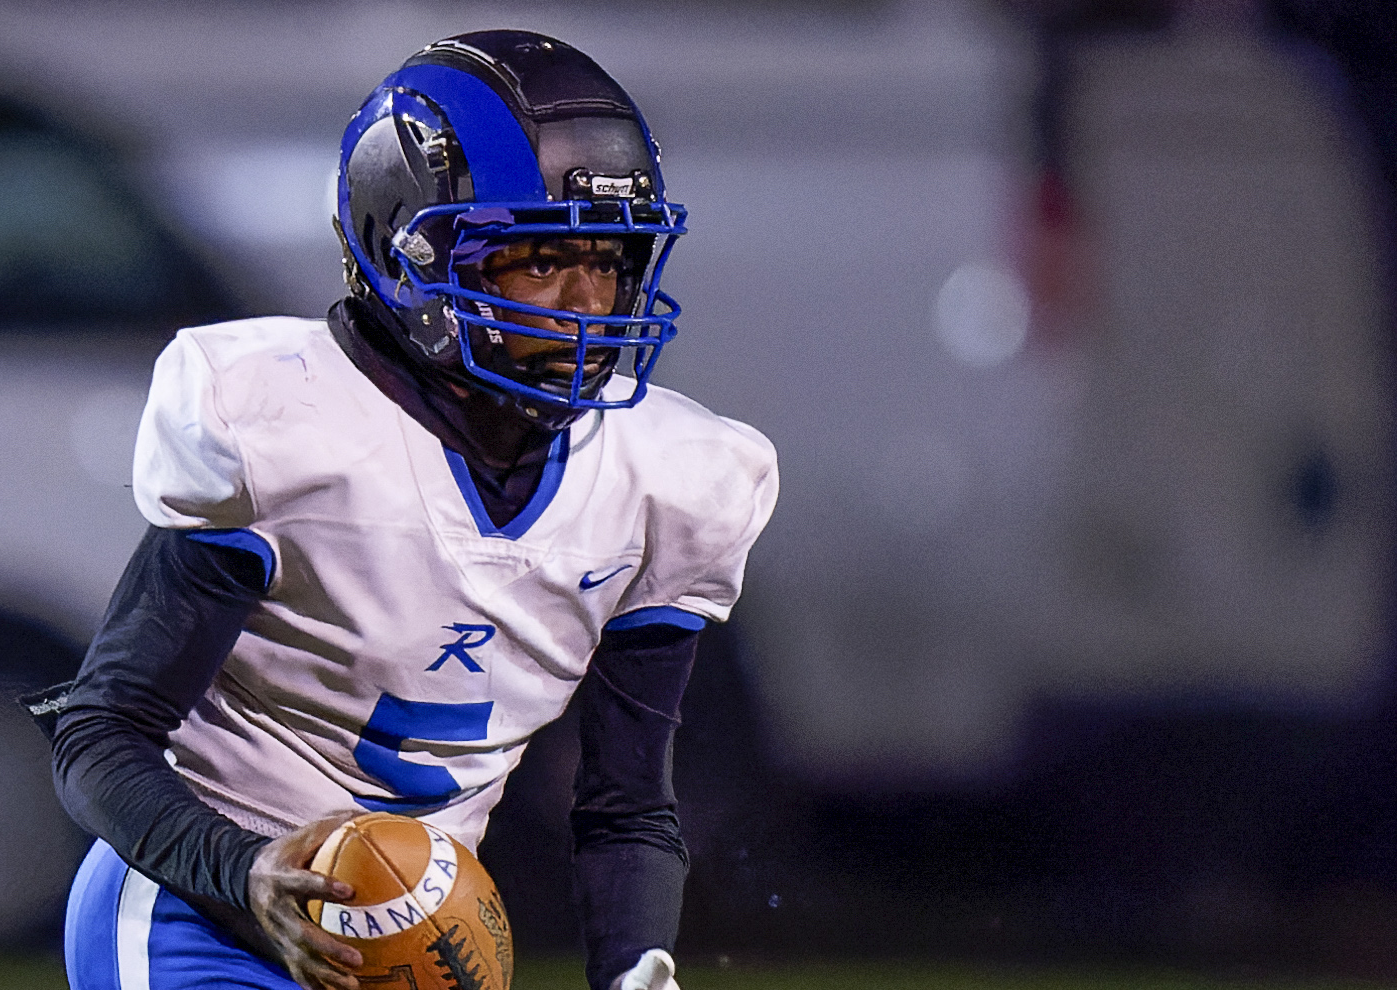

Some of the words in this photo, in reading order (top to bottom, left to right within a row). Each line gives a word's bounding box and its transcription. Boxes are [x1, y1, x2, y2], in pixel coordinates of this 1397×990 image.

[424, 622, 497, 673] R
[353, 691, 495, 814] 5
[338, 829, 457, 938] RAMSAY
